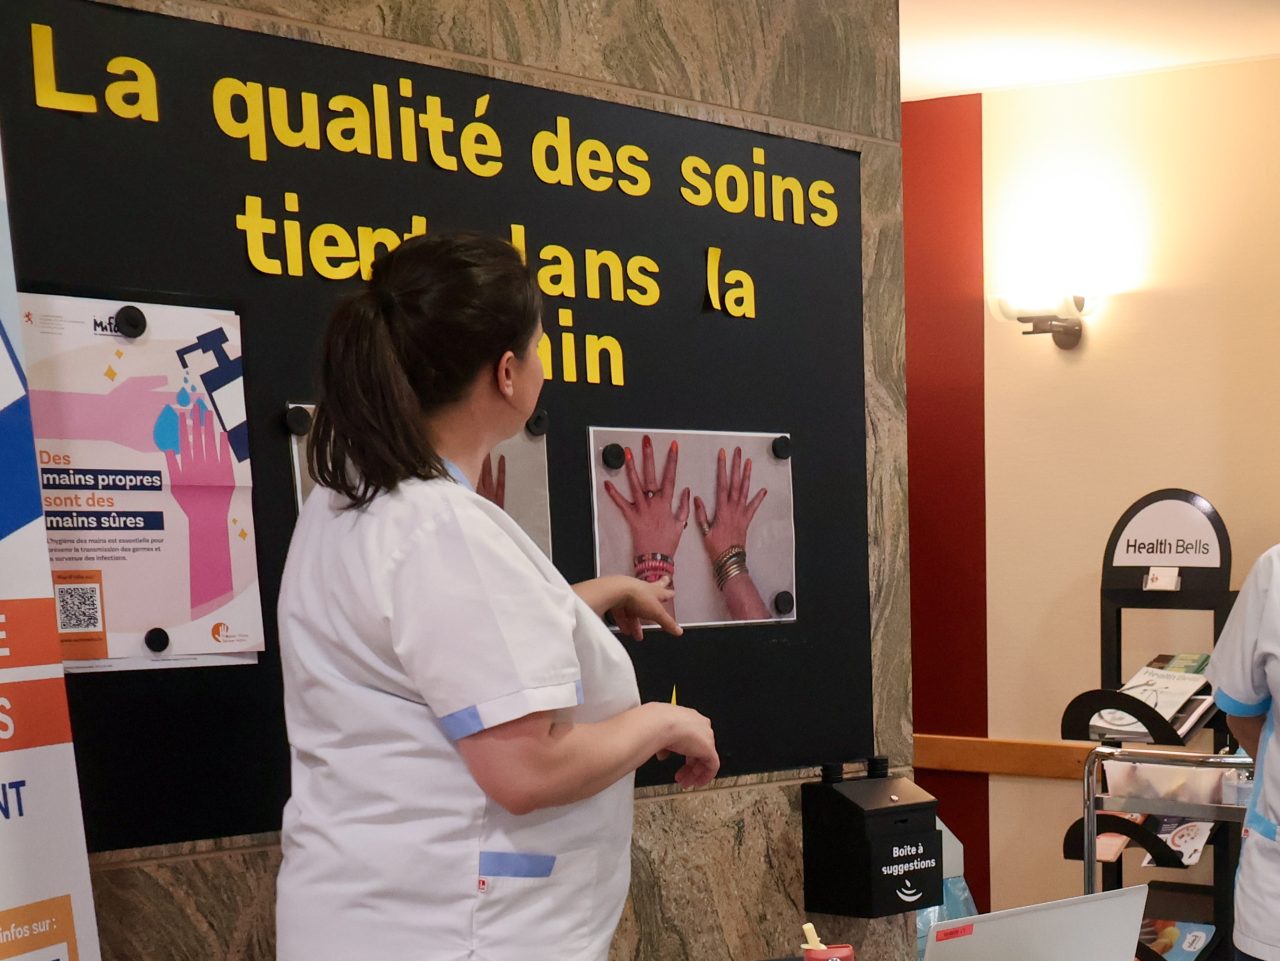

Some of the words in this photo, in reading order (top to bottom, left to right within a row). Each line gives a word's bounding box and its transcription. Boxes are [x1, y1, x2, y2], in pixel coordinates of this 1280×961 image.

[31, 23, 159, 122] La
[212, 77, 503, 177] qualité
[531, 116, 651, 197] des
[679, 147, 839, 228] soins
[706, 246, 756, 319] la
[39, 450, 72, 465] Des
[42, 469, 95, 486] mains
[98, 474, 162, 490] propres
[44, 494, 82, 508] sont
[85, 492, 115, 508] des
[46, 512, 97, 528] mains
[100, 512, 145, 528] sûres
[1126, 538, 1173, 554] Health
[1175, 538, 1210, 555] Bells
[892, 845, 917, 858] Boîte
[917, 842, 924, 854] à
[881, 858, 936, 876] suggestions
